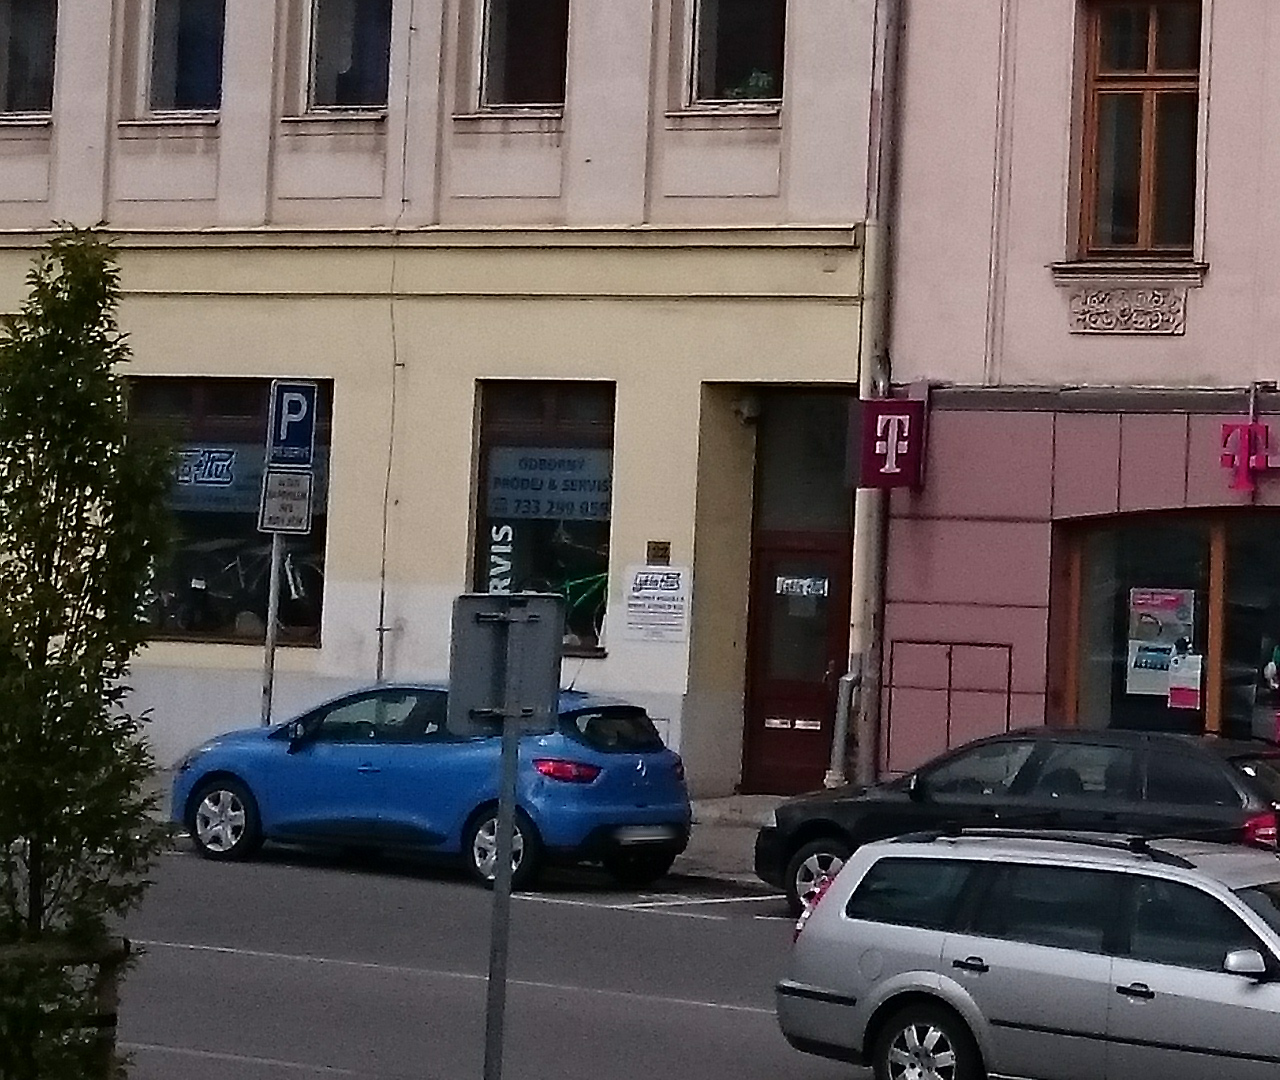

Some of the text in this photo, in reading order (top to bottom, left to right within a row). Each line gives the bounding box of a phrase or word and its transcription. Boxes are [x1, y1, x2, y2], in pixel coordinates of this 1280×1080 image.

[280, 392, 308, 441] P
[874, 414, 911, 474] T
[493, 476, 544, 491] PRODEJ
[562, 478, 610, 493] SERVIS
[489, 525, 513, 595] RVIS
